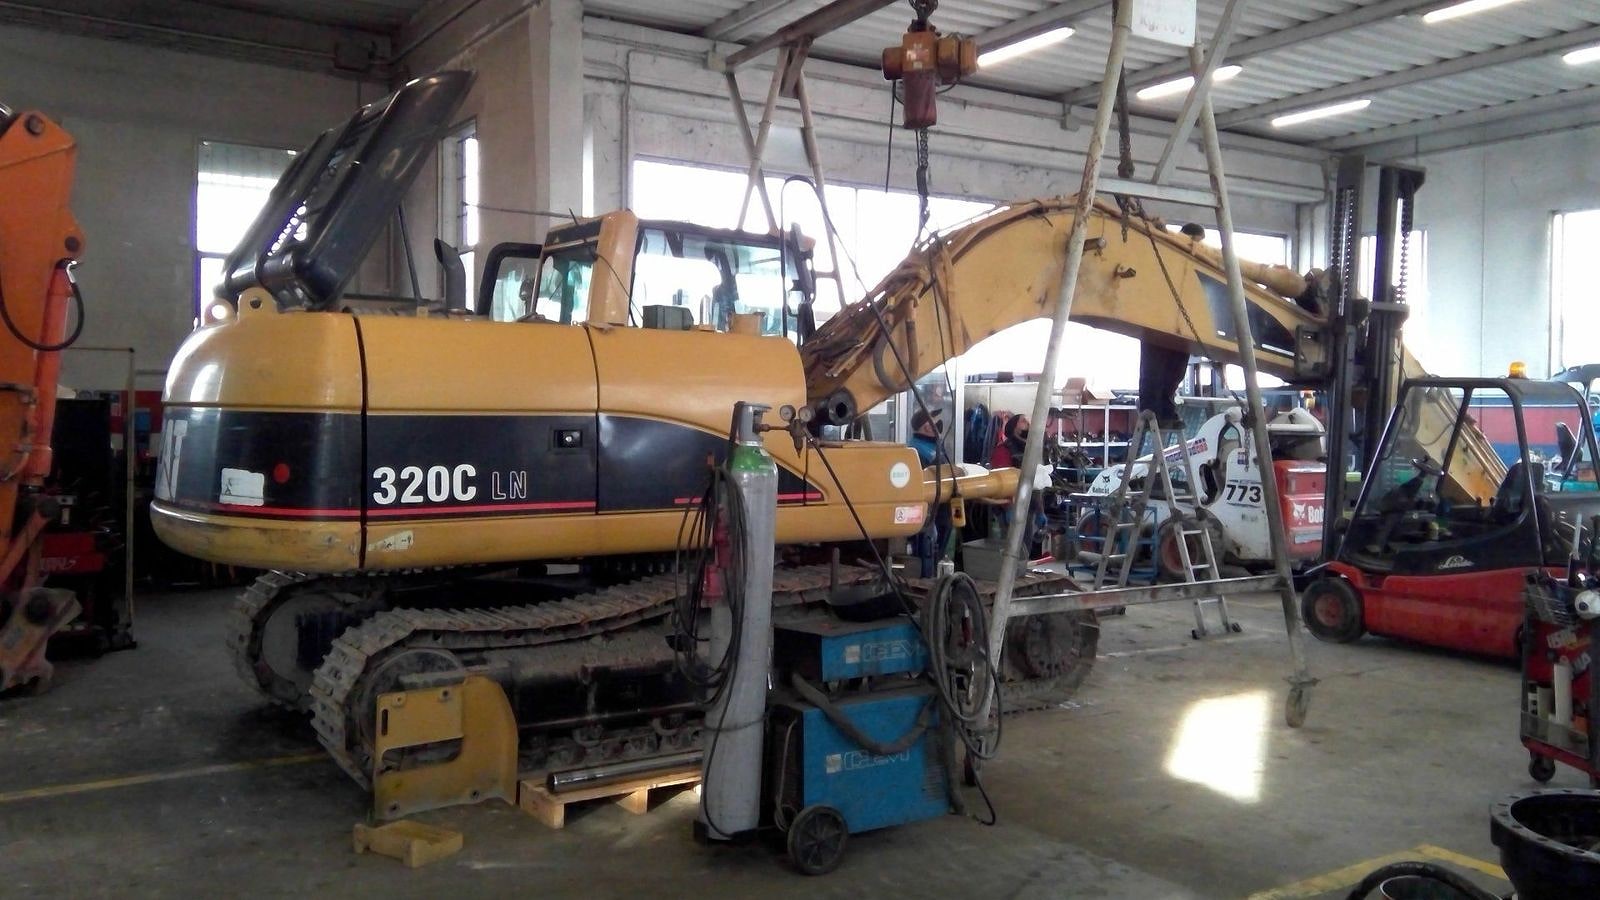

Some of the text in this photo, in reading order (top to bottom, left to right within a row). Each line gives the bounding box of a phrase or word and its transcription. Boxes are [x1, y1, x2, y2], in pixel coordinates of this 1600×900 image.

[372, 463, 527, 505] 320C LN
[1226, 484, 1262, 503] 773
[1307, 505, 1325, 524] Bob
